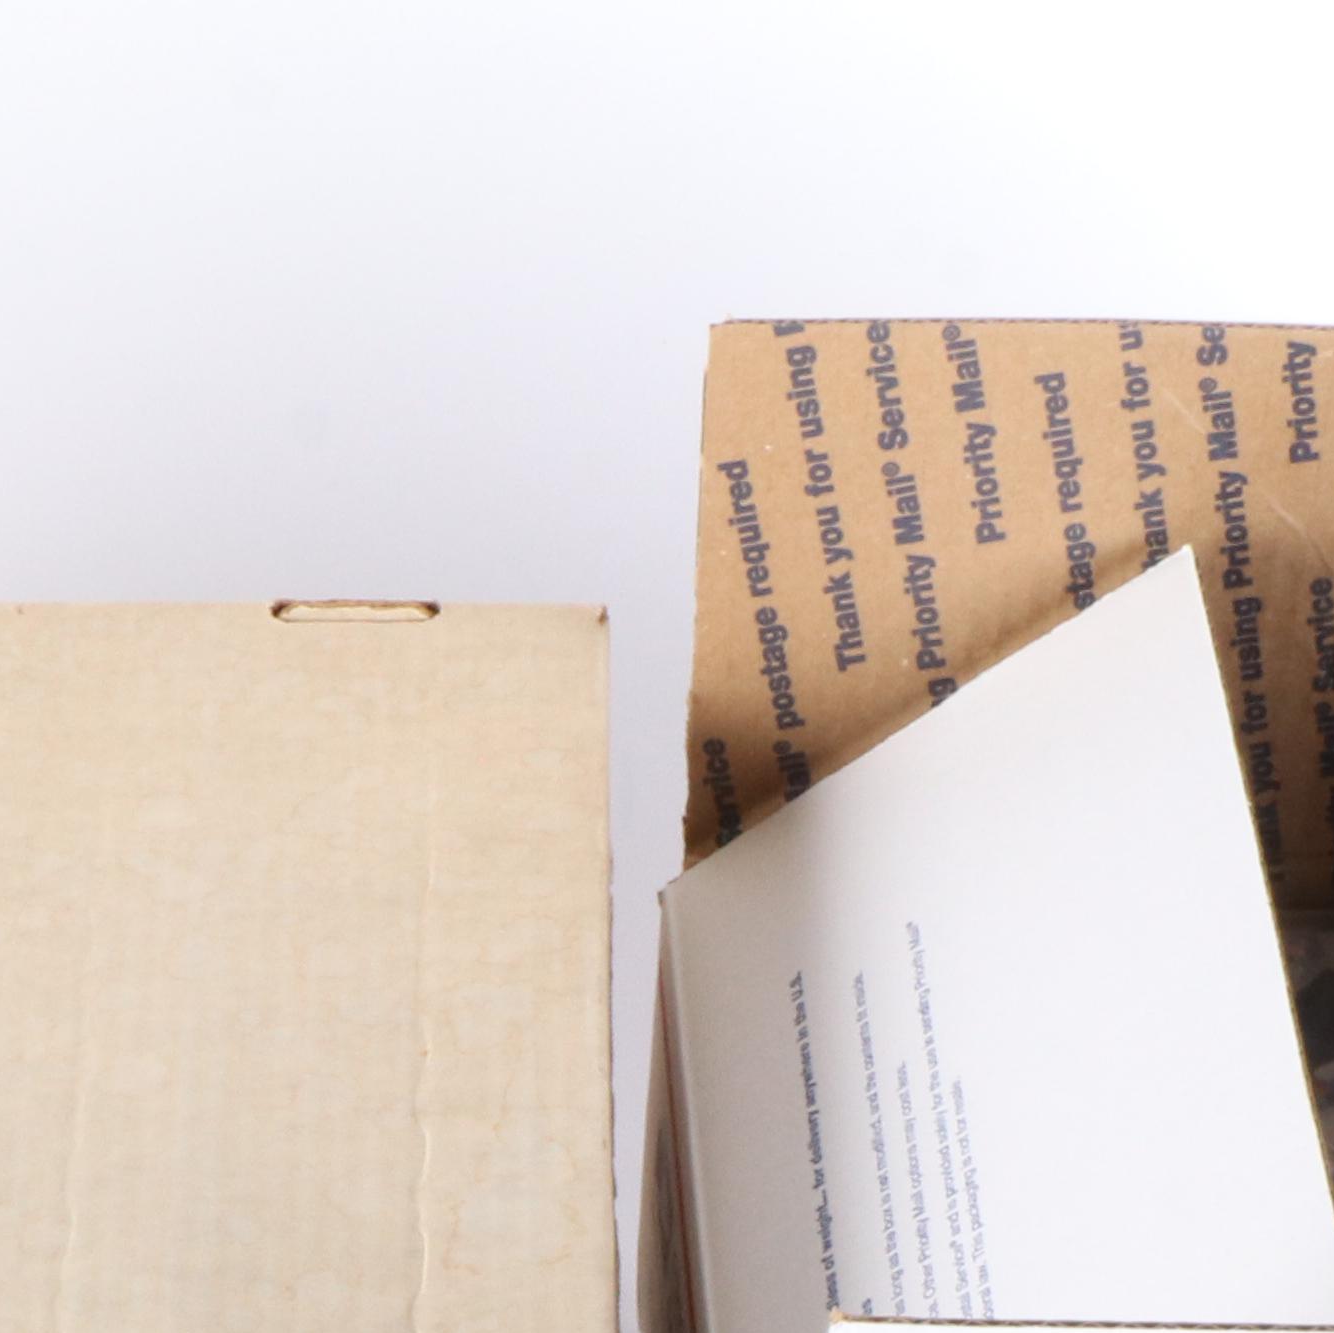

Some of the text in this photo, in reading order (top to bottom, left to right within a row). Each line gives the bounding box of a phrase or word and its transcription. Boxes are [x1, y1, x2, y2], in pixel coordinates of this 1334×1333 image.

[1034, 371, 1083, 515] required
[1283, 340, 1321, 464] Priority
[786, 345, 867, 672] Thank you for using
[865, 320, 947, 670] Priority Service
[963, 421, 1007, 544] Priority
[1214, 471, 1251, 593] Priority
[717, 460, 802, 730] postage required
